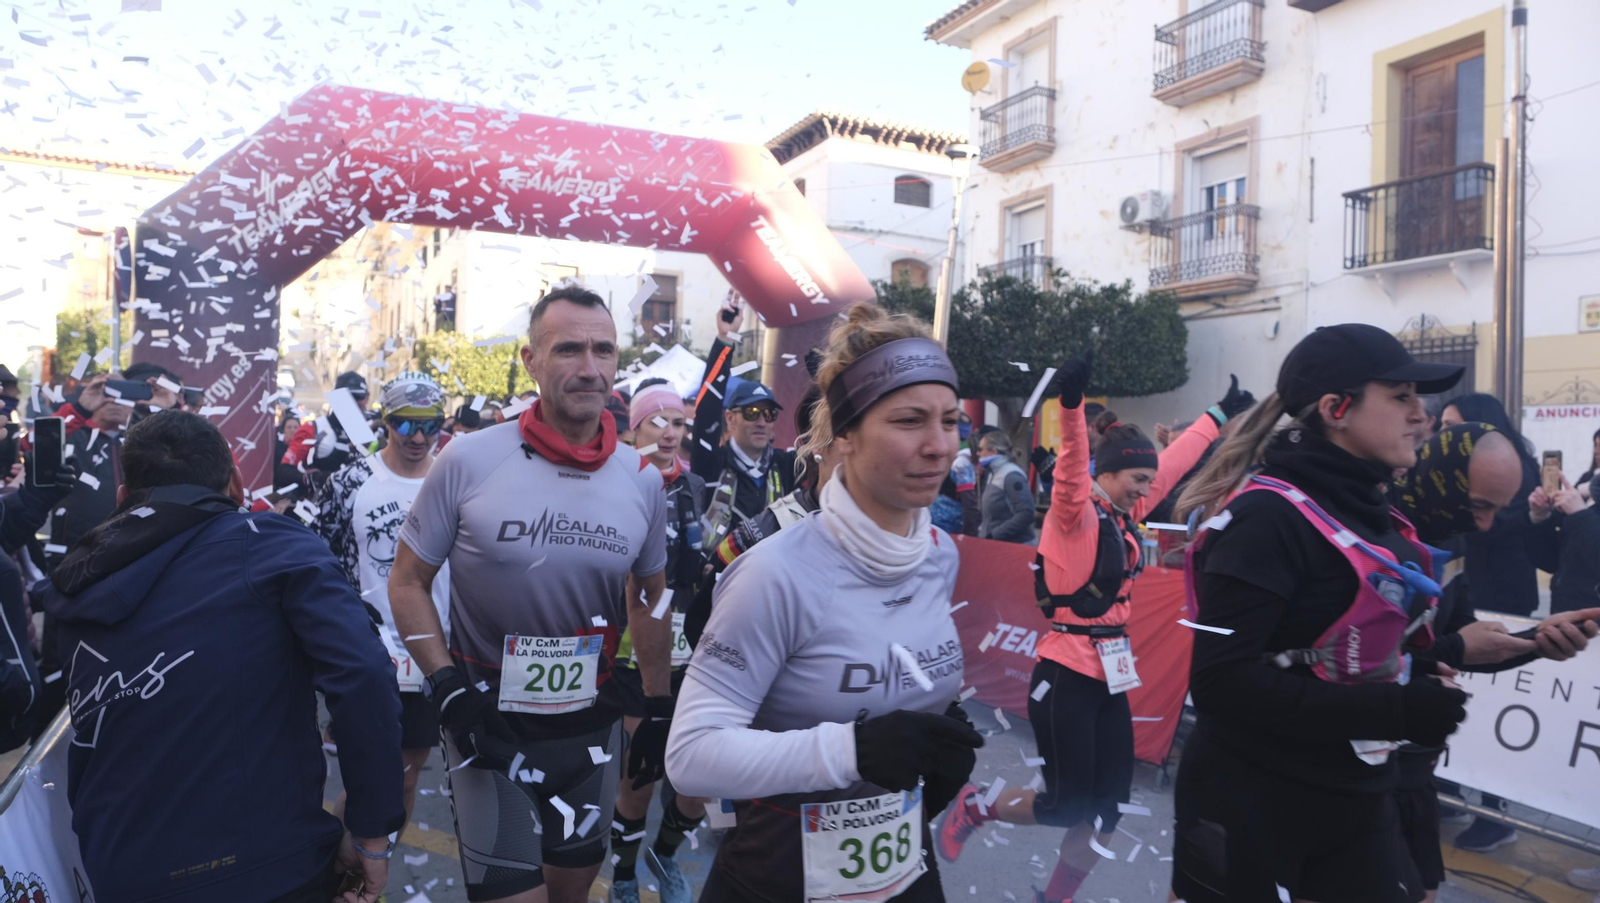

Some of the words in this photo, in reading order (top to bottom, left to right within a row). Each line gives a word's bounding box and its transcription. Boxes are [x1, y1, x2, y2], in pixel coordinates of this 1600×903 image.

[1535, 406, 1600, 419] ANUNCI
[555, 519, 617, 539] CALAR
[549, 535, 576, 546] RIO
[578, 536, 629, 556] MUNDO
[520, 637, 533, 647] IV
[535, 638, 560, 648] CxM
[990, 622, 1048, 659] TEA
[516, 649, 528, 657] LA
[531, 648, 573, 658] PÓLVORA
[1117, 656, 1129, 676] 49
[524, 661, 583, 693] 202
[114, 686, 141, 700] STOP
[826, 803, 841, 816] IV
[847, 798, 881, 814] CxM
[842, 809, 901, 830] PÓLVORA
[838, 821, 911, 879] 368
